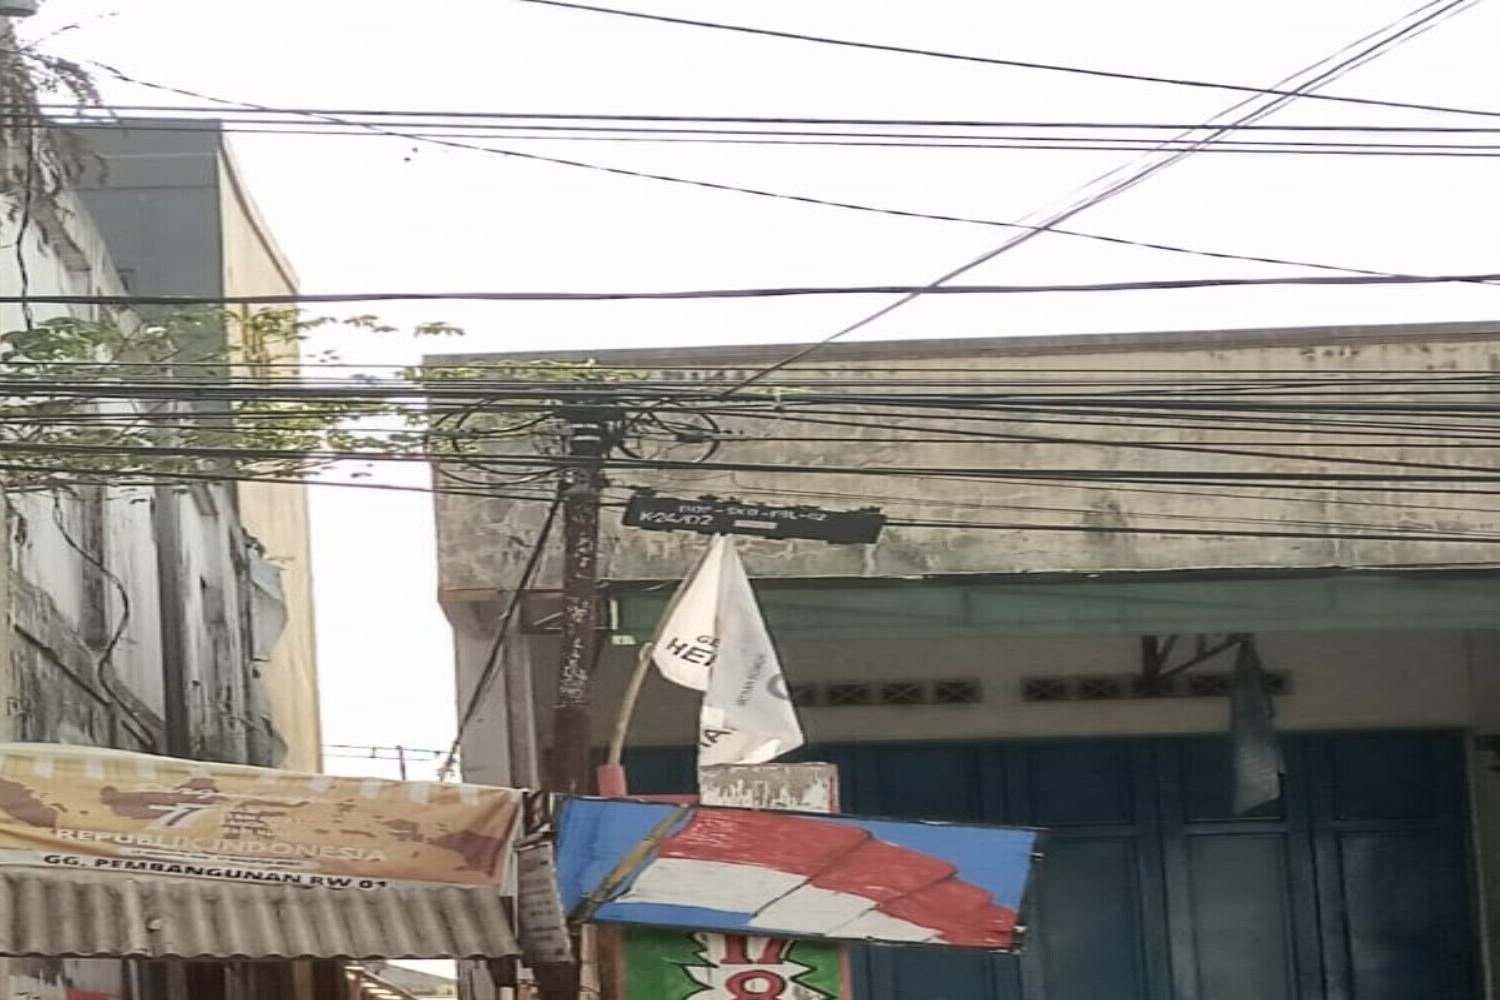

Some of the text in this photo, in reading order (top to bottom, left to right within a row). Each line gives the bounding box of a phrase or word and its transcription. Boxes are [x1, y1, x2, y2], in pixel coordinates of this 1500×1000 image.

[210, 837, 388, 863] INDONESIA
[43, 854, 87, 867] GG.
[94, 858, 301, 885] PEMBANGUNAN
[309, 876, 353, 888] RW
